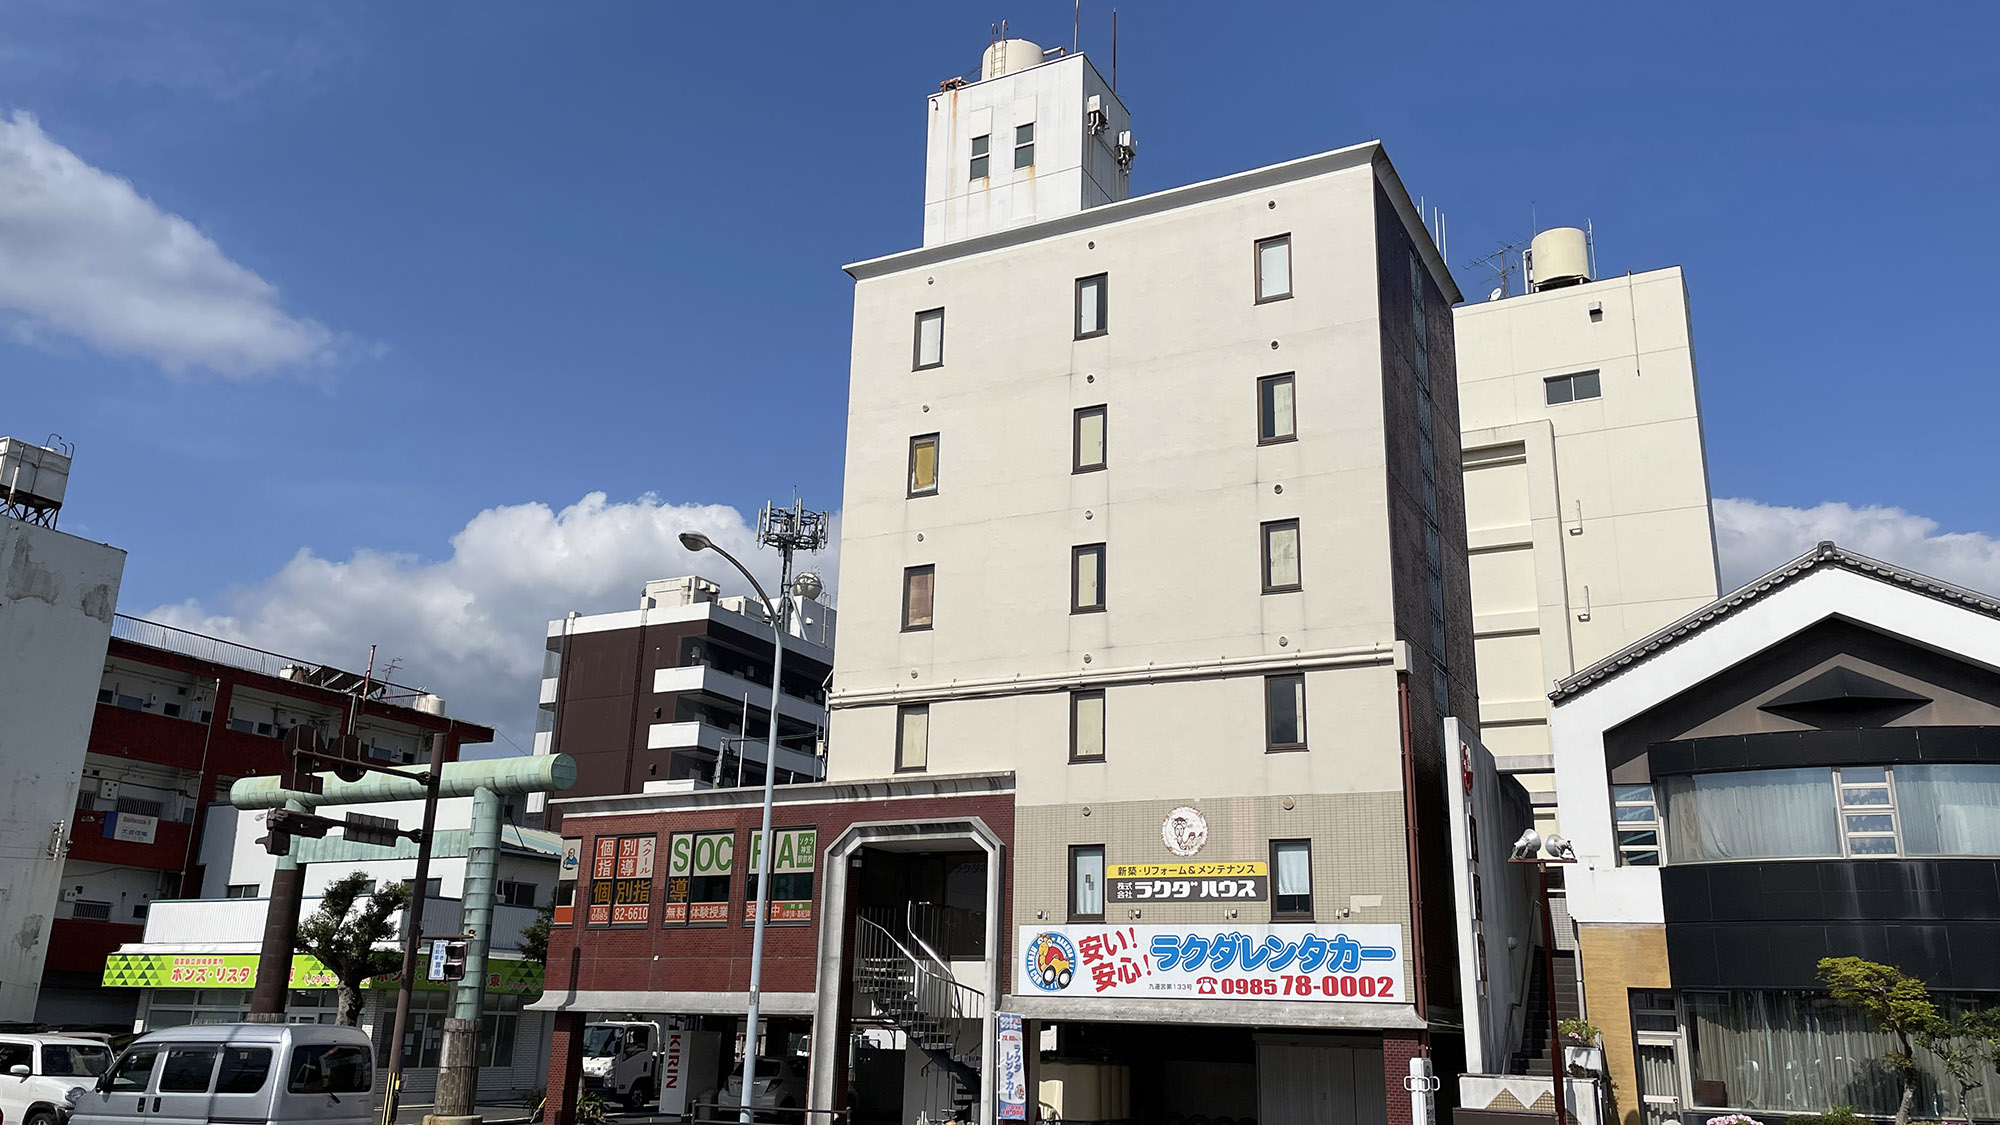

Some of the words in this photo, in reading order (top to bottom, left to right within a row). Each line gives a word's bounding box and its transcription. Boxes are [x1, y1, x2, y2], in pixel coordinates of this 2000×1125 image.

[600, 839, 637, 857] 個別
[799, 836, 814, 845] ソクラ
[640, 839, 652, 874] スクール
[598, 859, 634, 876] 指導
[1117, 881, 1133, 890] 株式
[1117, 890, 1133, 899] 会社
[1134, 880, 1257, 898] ラクダハウス
[591, 912, 608, 921] 0985
[614, 906, 648, 920] 82-6610
[746, 904, 781, 918] 受中
[1078, 927, 1138, 966] 安い!
[1150, 931, 1397, 973] ラクダレンタカー
[1091, 953, 1152, 993] 安心!
[1221, 978, 1277, 995] 0985
[1280, 975, 1394, 997] 78-0002
[666, 1034, 682, 1089] KIRIN
[1014, 1044, 1022, 1073] ラクダ
[1005, 1052, 1014, 1100] レンタカー
